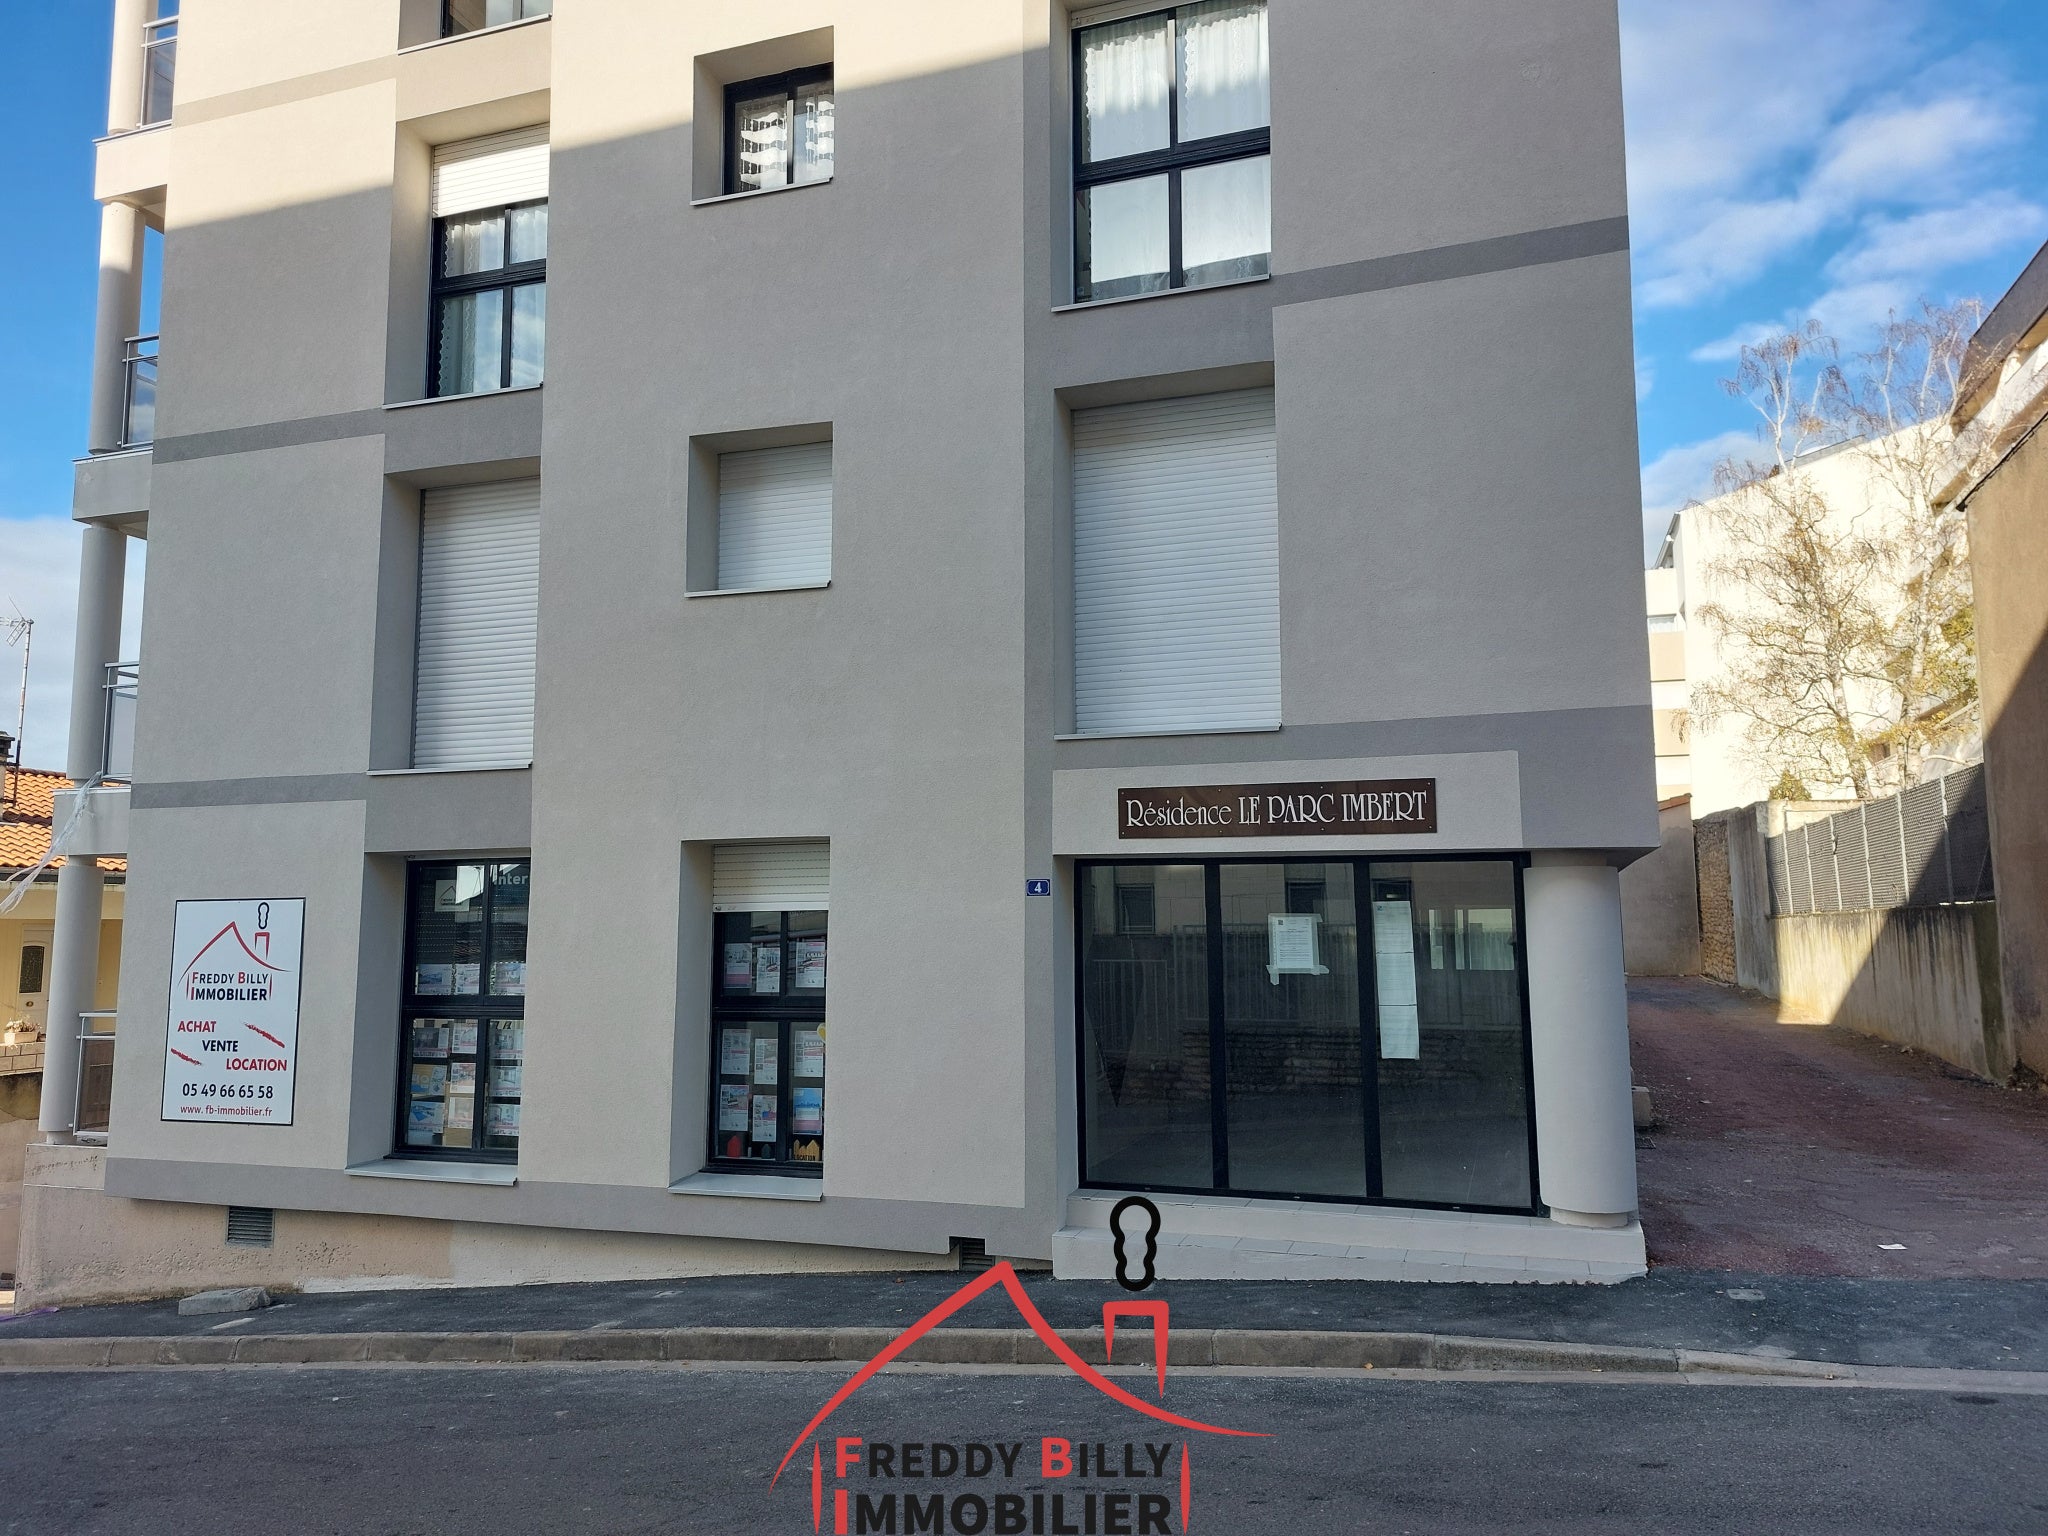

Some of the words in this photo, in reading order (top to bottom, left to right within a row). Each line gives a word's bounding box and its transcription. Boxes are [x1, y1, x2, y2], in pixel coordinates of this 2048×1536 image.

[1125, 796, 1232, 827] Résidence
[1238, 796, 1261, 825] LE
[1267, 792, 1336, 823] PARC
[1341, 790, 1427, 822] IMBERT
[1034, 881, 1042, 894] 4
[192, 971, 235, 984] FREDDY
[238, 971, 269, 984] BILLY
[190, 986, 267, 1001] IMMOBILIER
[177, 1020, 217, 1033] ACHAT
[202, 1040, 239, 1052] VENTE
[226, 1058, 287, 1071] LOCATION
[182, 1083, 197, 1097] 05
[201, 1083, 217, 1097] 49
[220, 1084, 235, 1098] 66
[238, 1084, 254, 1098] 65
[257, 1085, 274, 1099] 58
